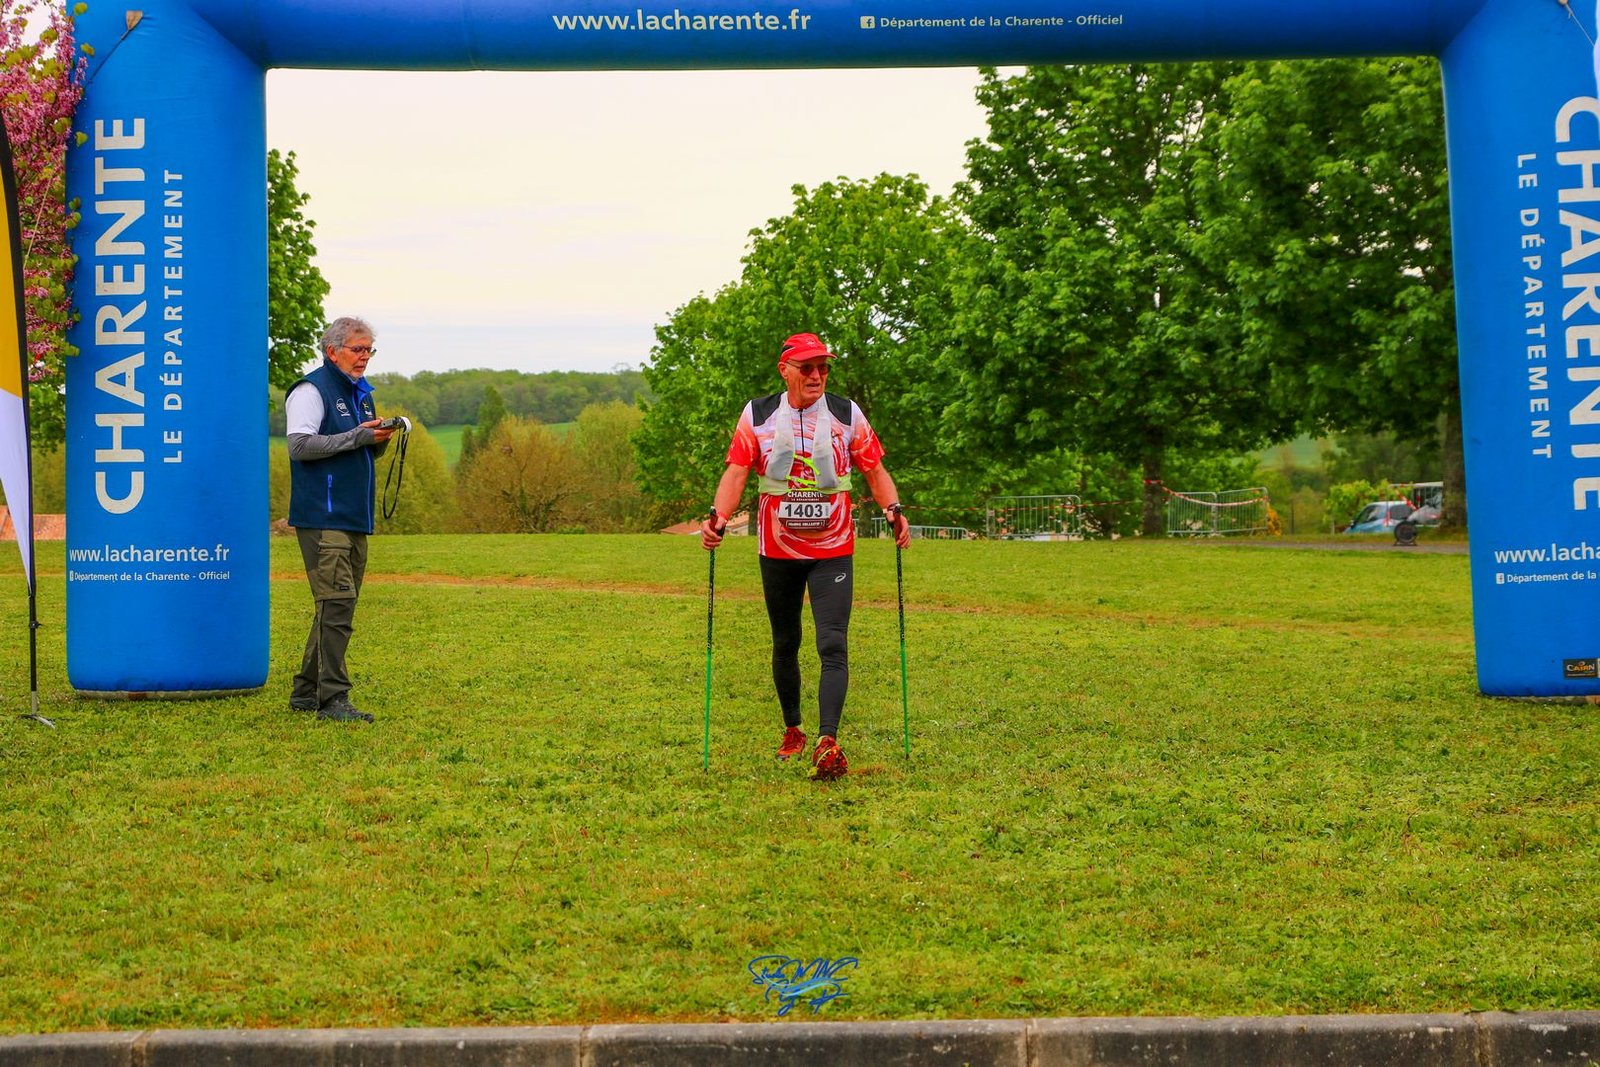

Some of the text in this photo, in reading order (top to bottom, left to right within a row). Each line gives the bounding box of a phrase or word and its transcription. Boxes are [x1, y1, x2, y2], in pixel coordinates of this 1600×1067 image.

[552, 9, 812, 31] www.lacharente.fr
[880, 16, 966, 29] Département
[969, 16, 986, 27] de
[989, 16, 1001, 26] la
[1005, 15, 1064, 26] Charente
[1076, 14, 1123, 25] Officiel
[1517, 153, 1552, 459] LE DÉPARTEMENT
[95, 118, 147, 514] CHARENTE
[159, 169, 183, 463] LE DÉPARTEMENT
[784, 503, 824, 518] 1403
[69, 543, 230, 562] www.lacharente.fr
[74, 571, 118, 583] Département
[120, 572, 132, 581] de
[134, 572, 143, 581] la
[145, 572, 190, 581] Charente
[198, 571, 230, 580] Officiel
[1507, 570, 1597, 584] Département de la
